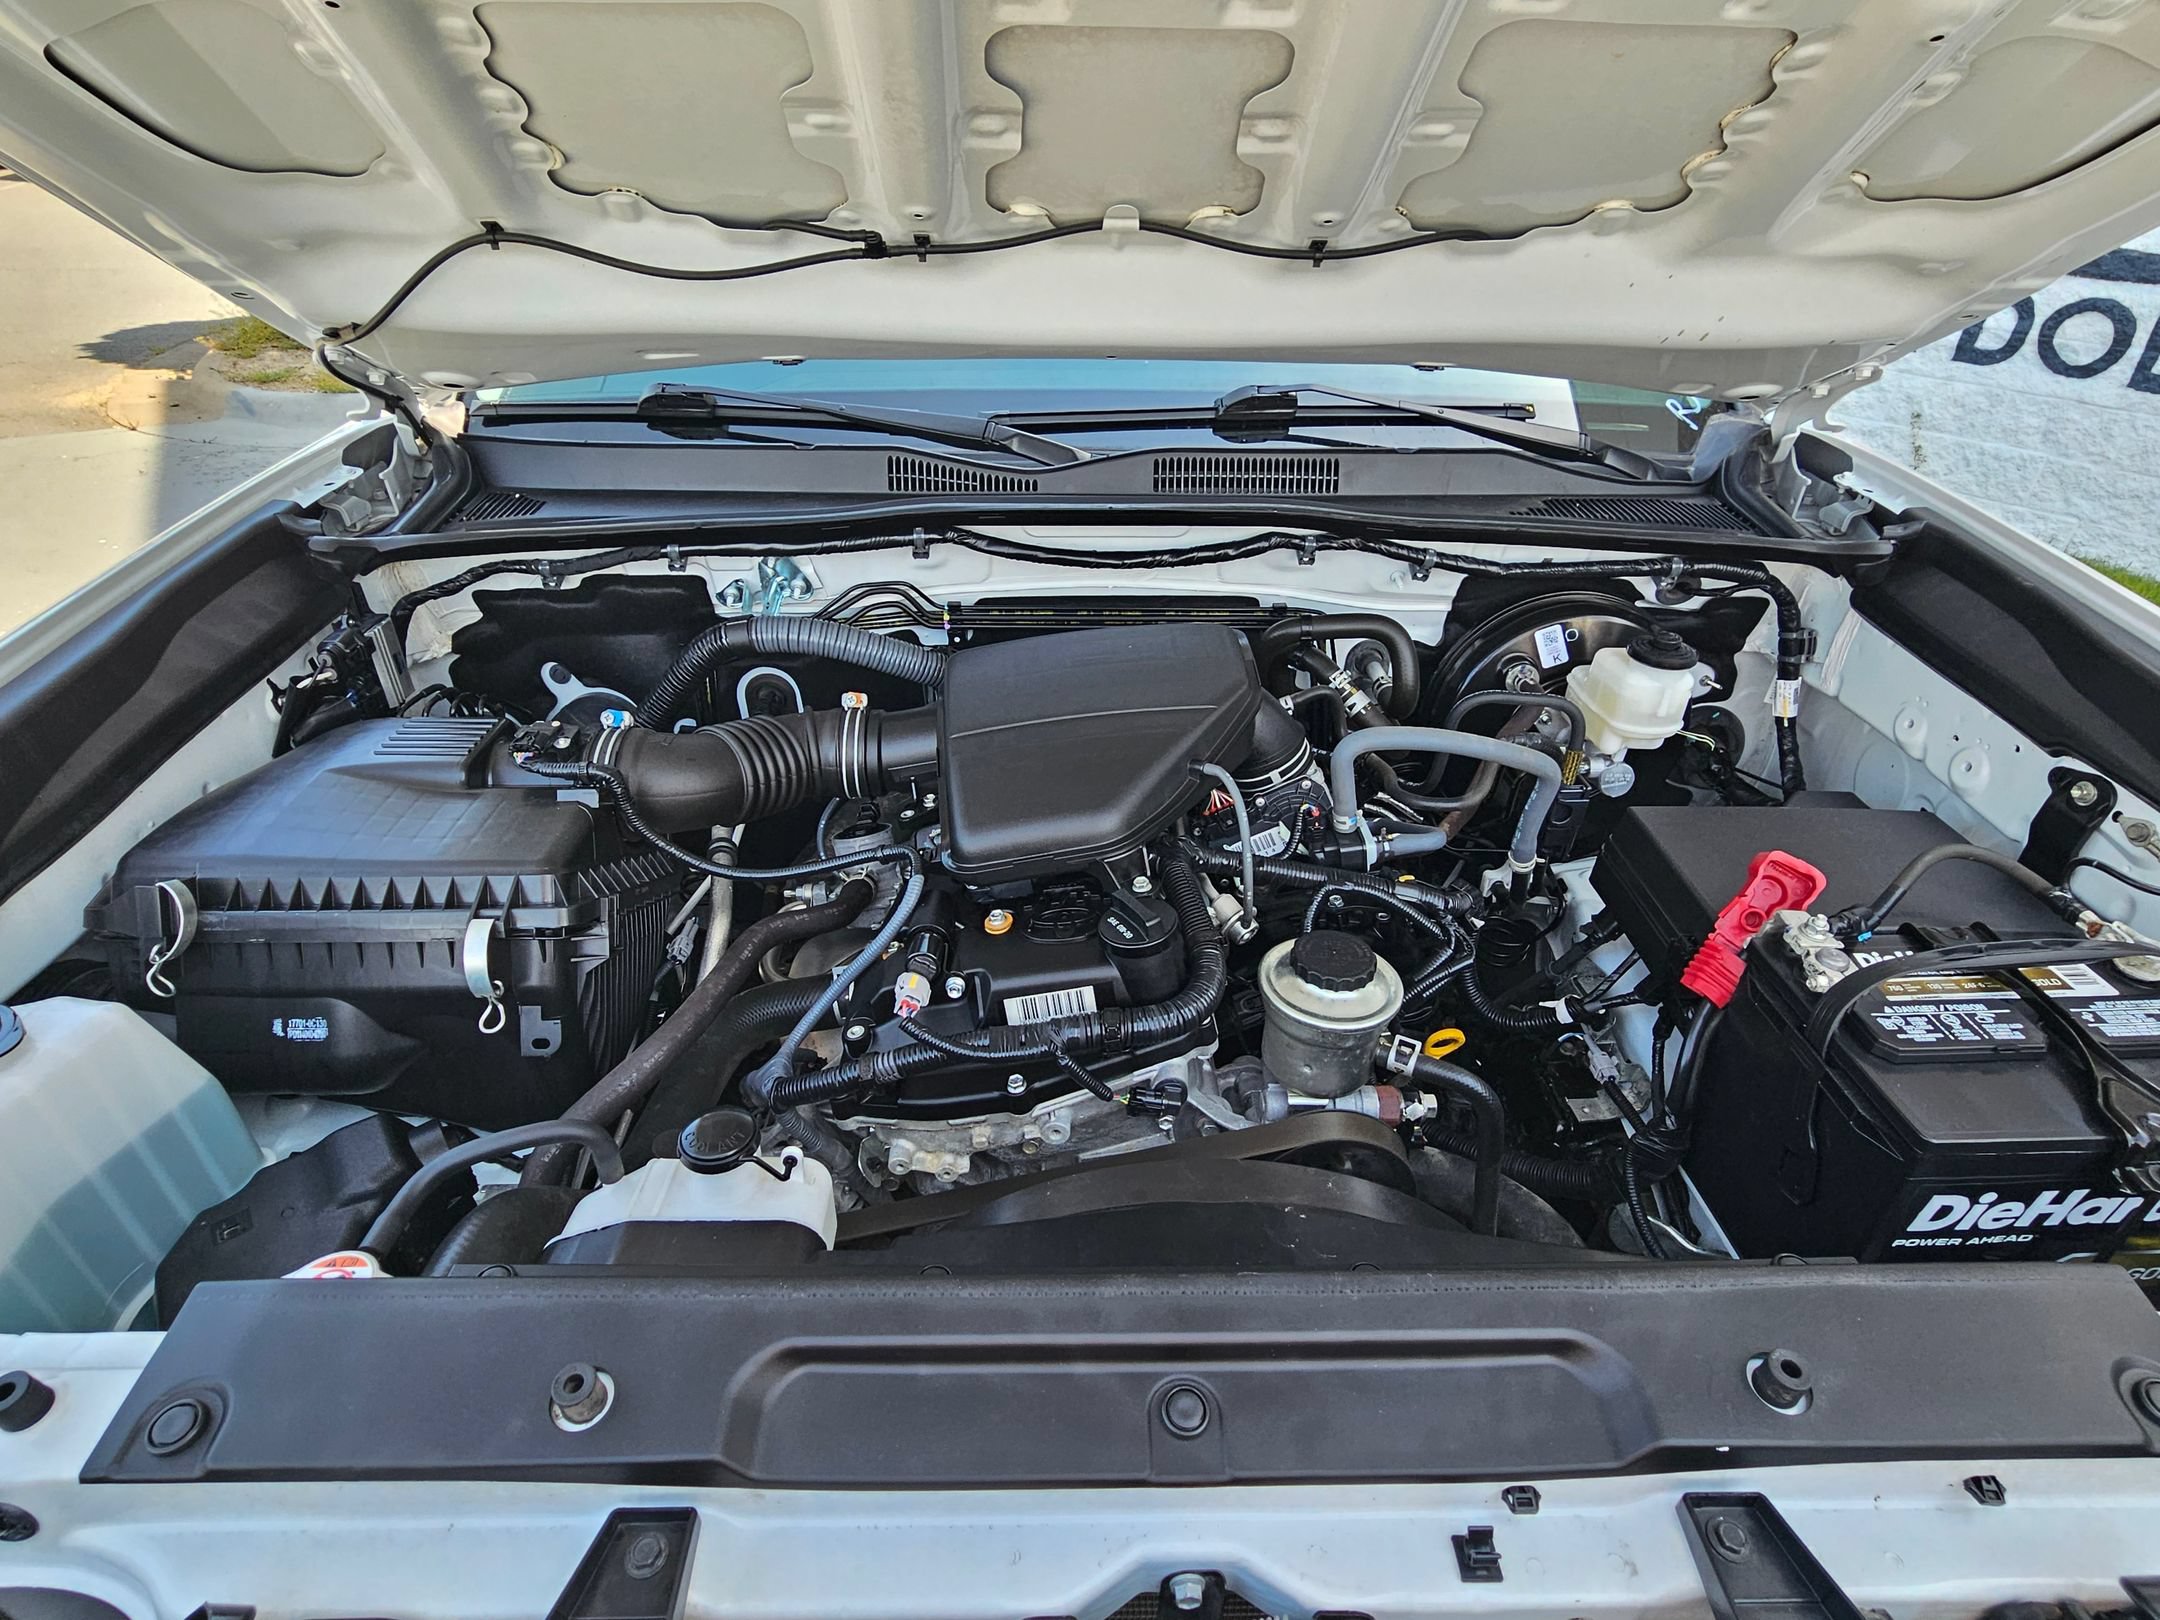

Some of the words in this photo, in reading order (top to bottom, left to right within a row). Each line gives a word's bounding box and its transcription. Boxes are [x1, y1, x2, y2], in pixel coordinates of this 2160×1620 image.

[1893, 1004, 1939, 1013] DANGER
[1945, 1003, 1988, 1012] POISON
[1892, 1237, 1963, 1247] POWER
[1965, 1234, 2034, 1245] AHEAD
[2128, 1267, 2160, 1280] GO
